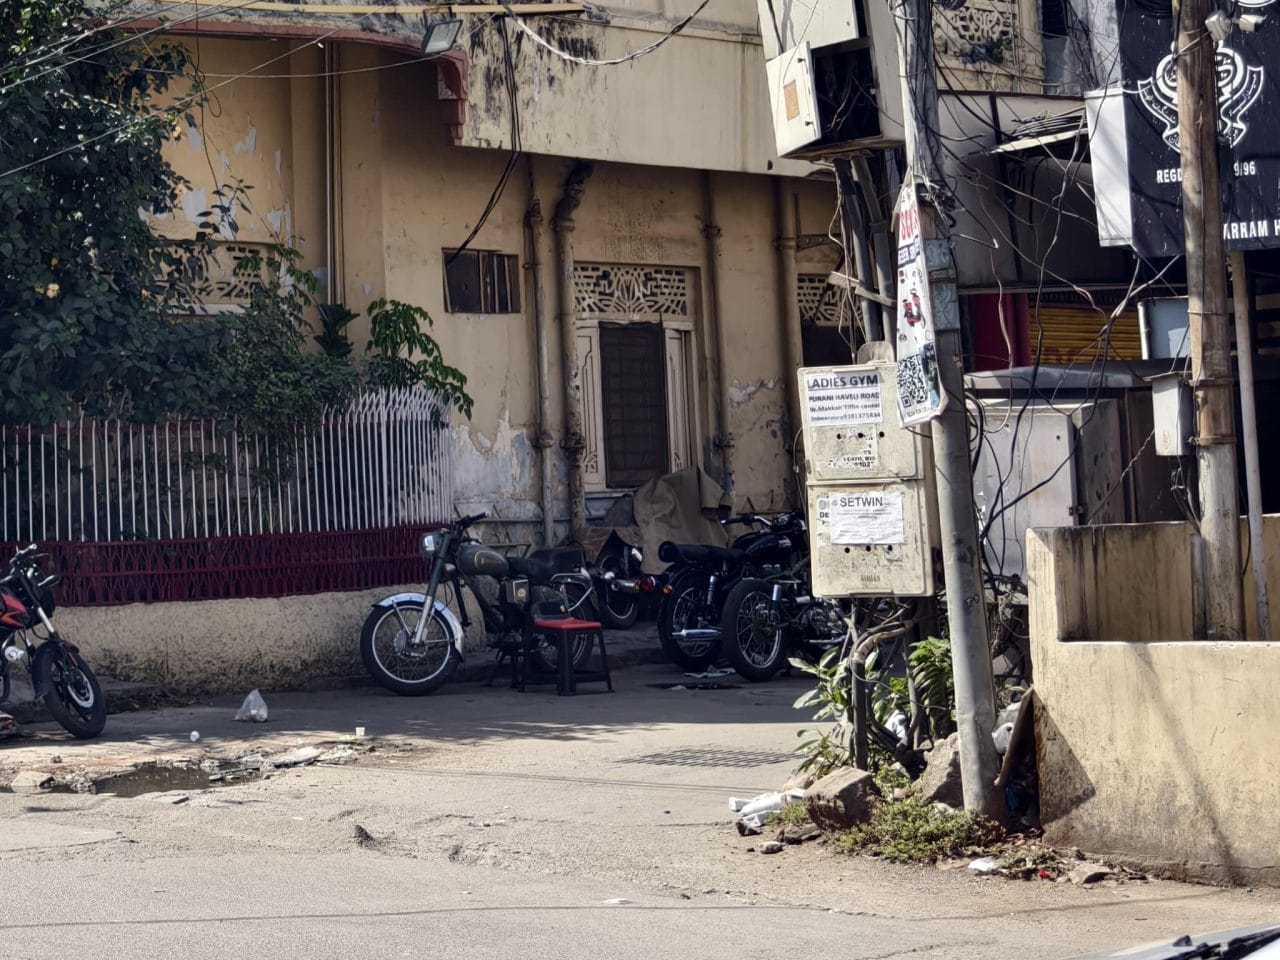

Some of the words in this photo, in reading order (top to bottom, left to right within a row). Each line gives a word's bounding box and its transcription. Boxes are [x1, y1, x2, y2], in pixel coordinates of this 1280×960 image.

[807, 376, 846, 389] LADIES
[849, 374, 878, 386] GYM
[840, 496, 883, 507] SETWIN
